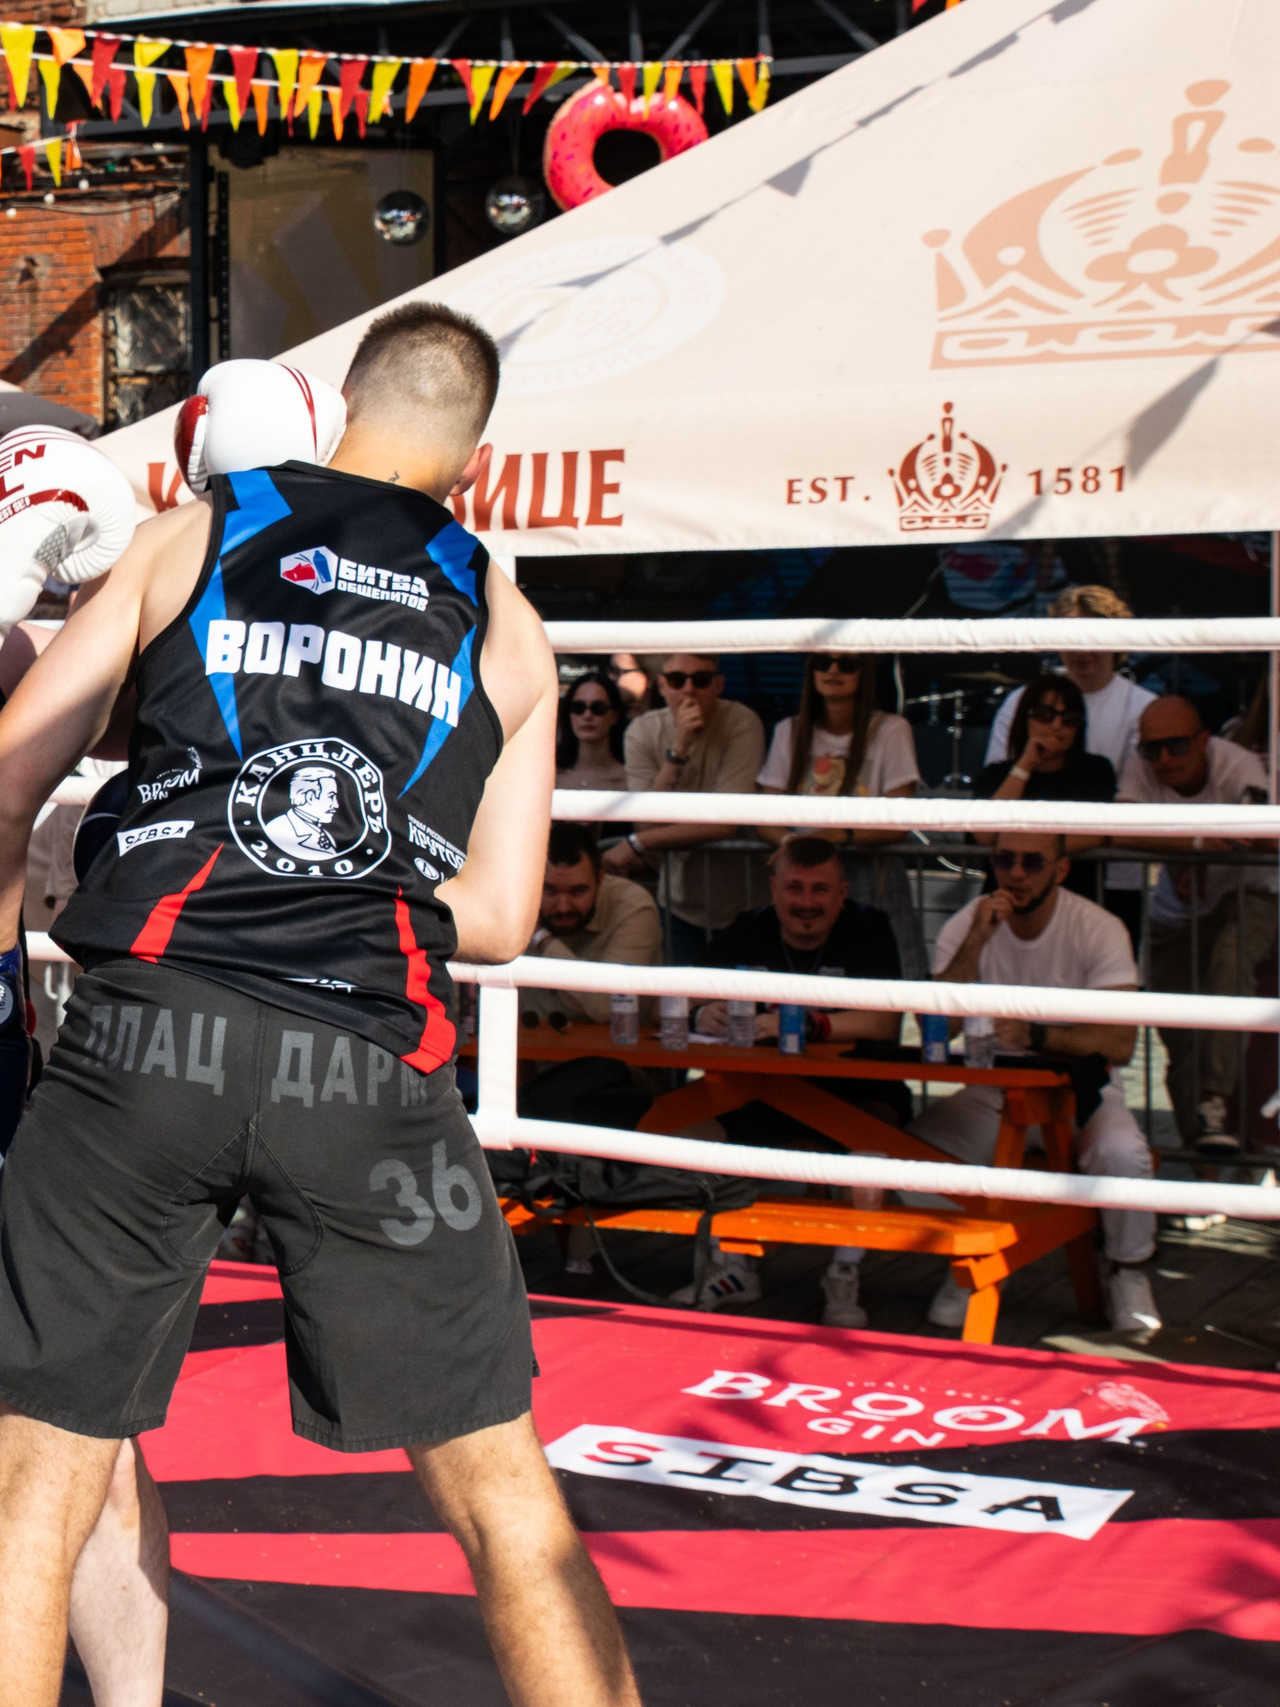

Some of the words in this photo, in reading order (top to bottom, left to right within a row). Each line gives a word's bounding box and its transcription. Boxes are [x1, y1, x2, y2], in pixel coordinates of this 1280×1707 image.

[785, 476, 872, 505] EST.
[1026, 466, 1128, 497] 1581
[338, 558, 430, 597] БИТВА
[206, 619, 462, 729] ВОРОНИН
[235, 742, 383, 834] КАНЦЛЕРЪ
[250, 839, 354, 876] 2010
[84, 1004, 228, 1096] ПЛАЦ
[369, 1141, 483, 1246] 36
[681, 1370, 1151, 1444] BROOM
[807, 1417, 948, 1446] GIN
[583, 1440, 1065, 1521] SIBSA
